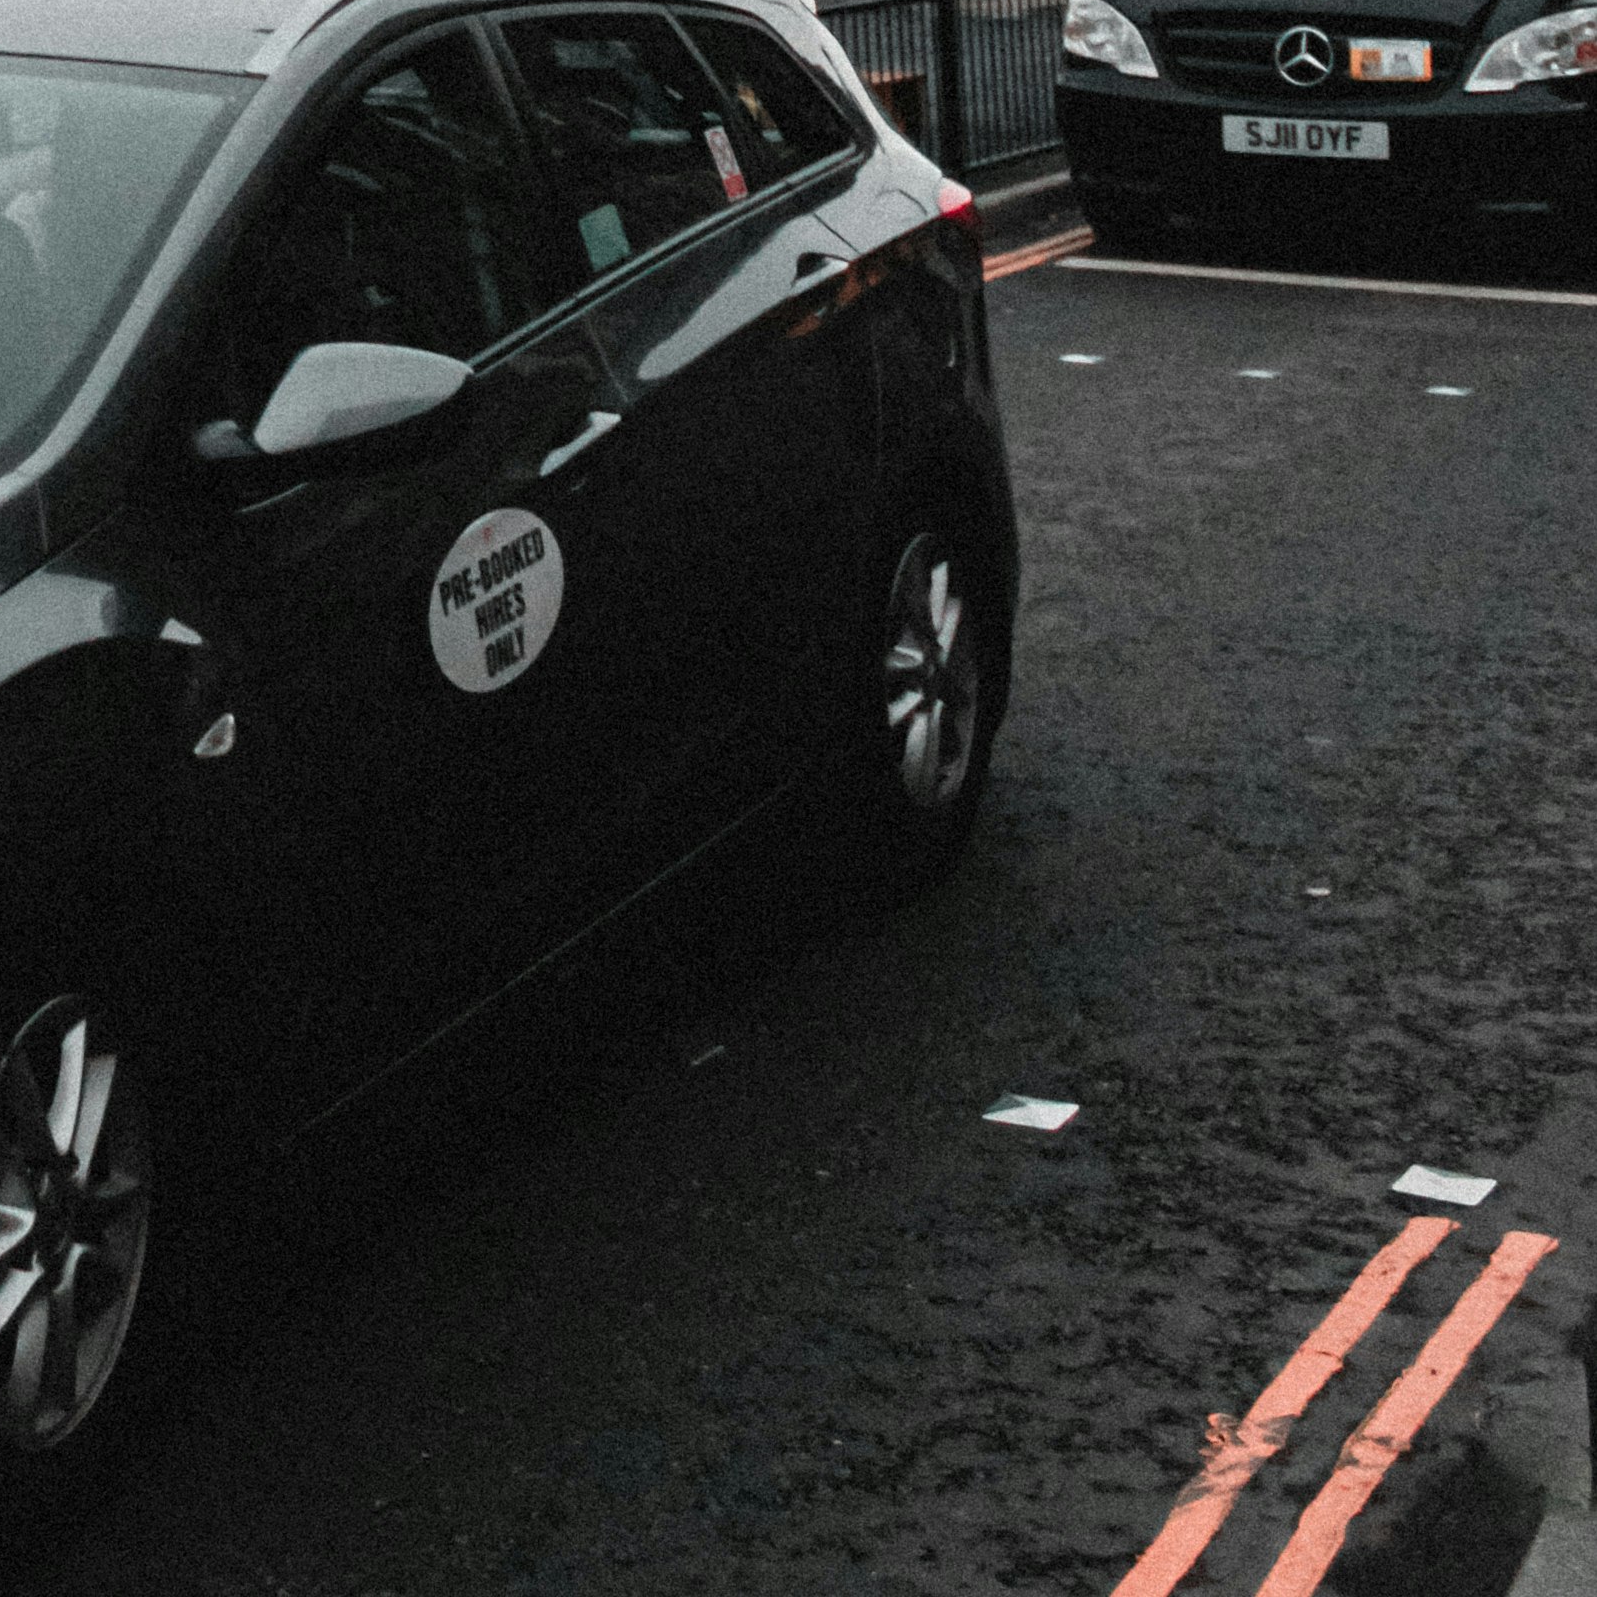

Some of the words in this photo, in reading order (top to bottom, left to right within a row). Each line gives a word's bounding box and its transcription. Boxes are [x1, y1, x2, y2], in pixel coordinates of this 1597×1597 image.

[1245, 120, 1298, 150] SJ11
[438, 527, 545, 618] PRE-BOOKED
[475, 582, 527, 639] HIRES
[485, 624, 526, 678] ONLY
